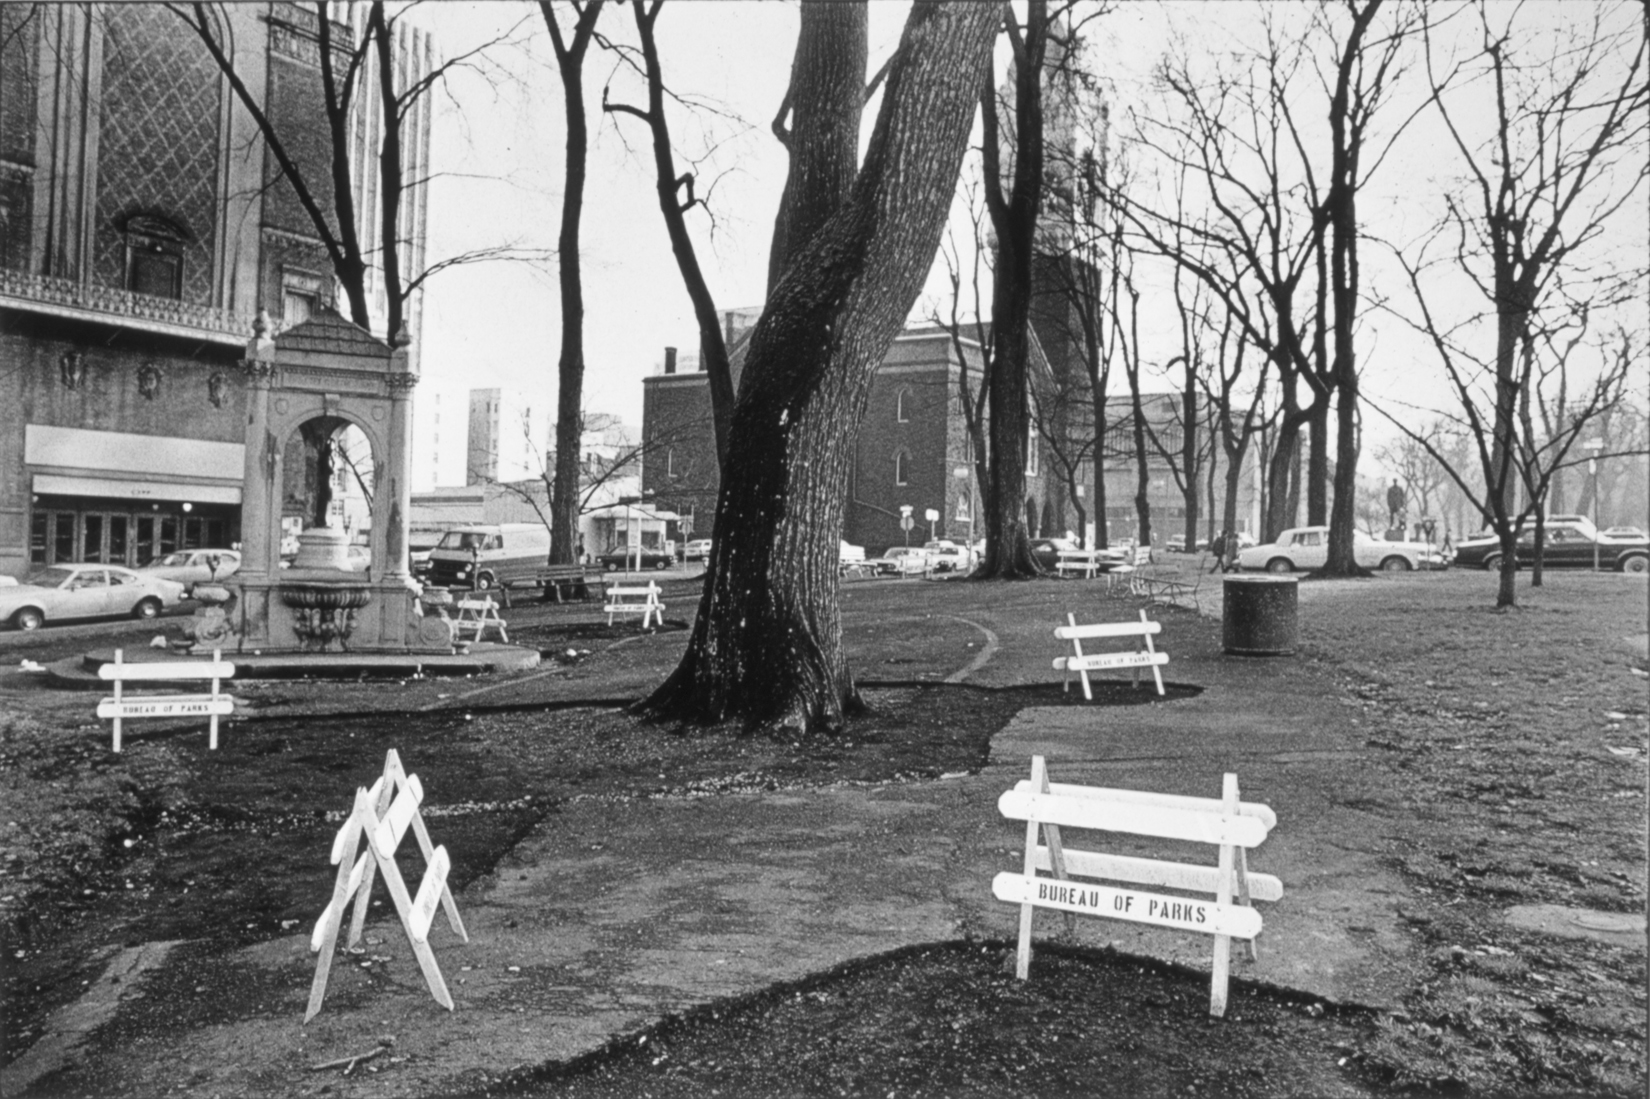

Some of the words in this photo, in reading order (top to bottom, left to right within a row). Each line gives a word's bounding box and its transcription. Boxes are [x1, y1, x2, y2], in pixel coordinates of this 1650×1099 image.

[123, 706, 156, 714] BUREAU
[181, 704, 209, 712] PARKS
[1038, 882, 1099, 908] BUREAU
[1114, 894, 1134, 913] OF
[1149, 899, 1207, 924] PARKS
